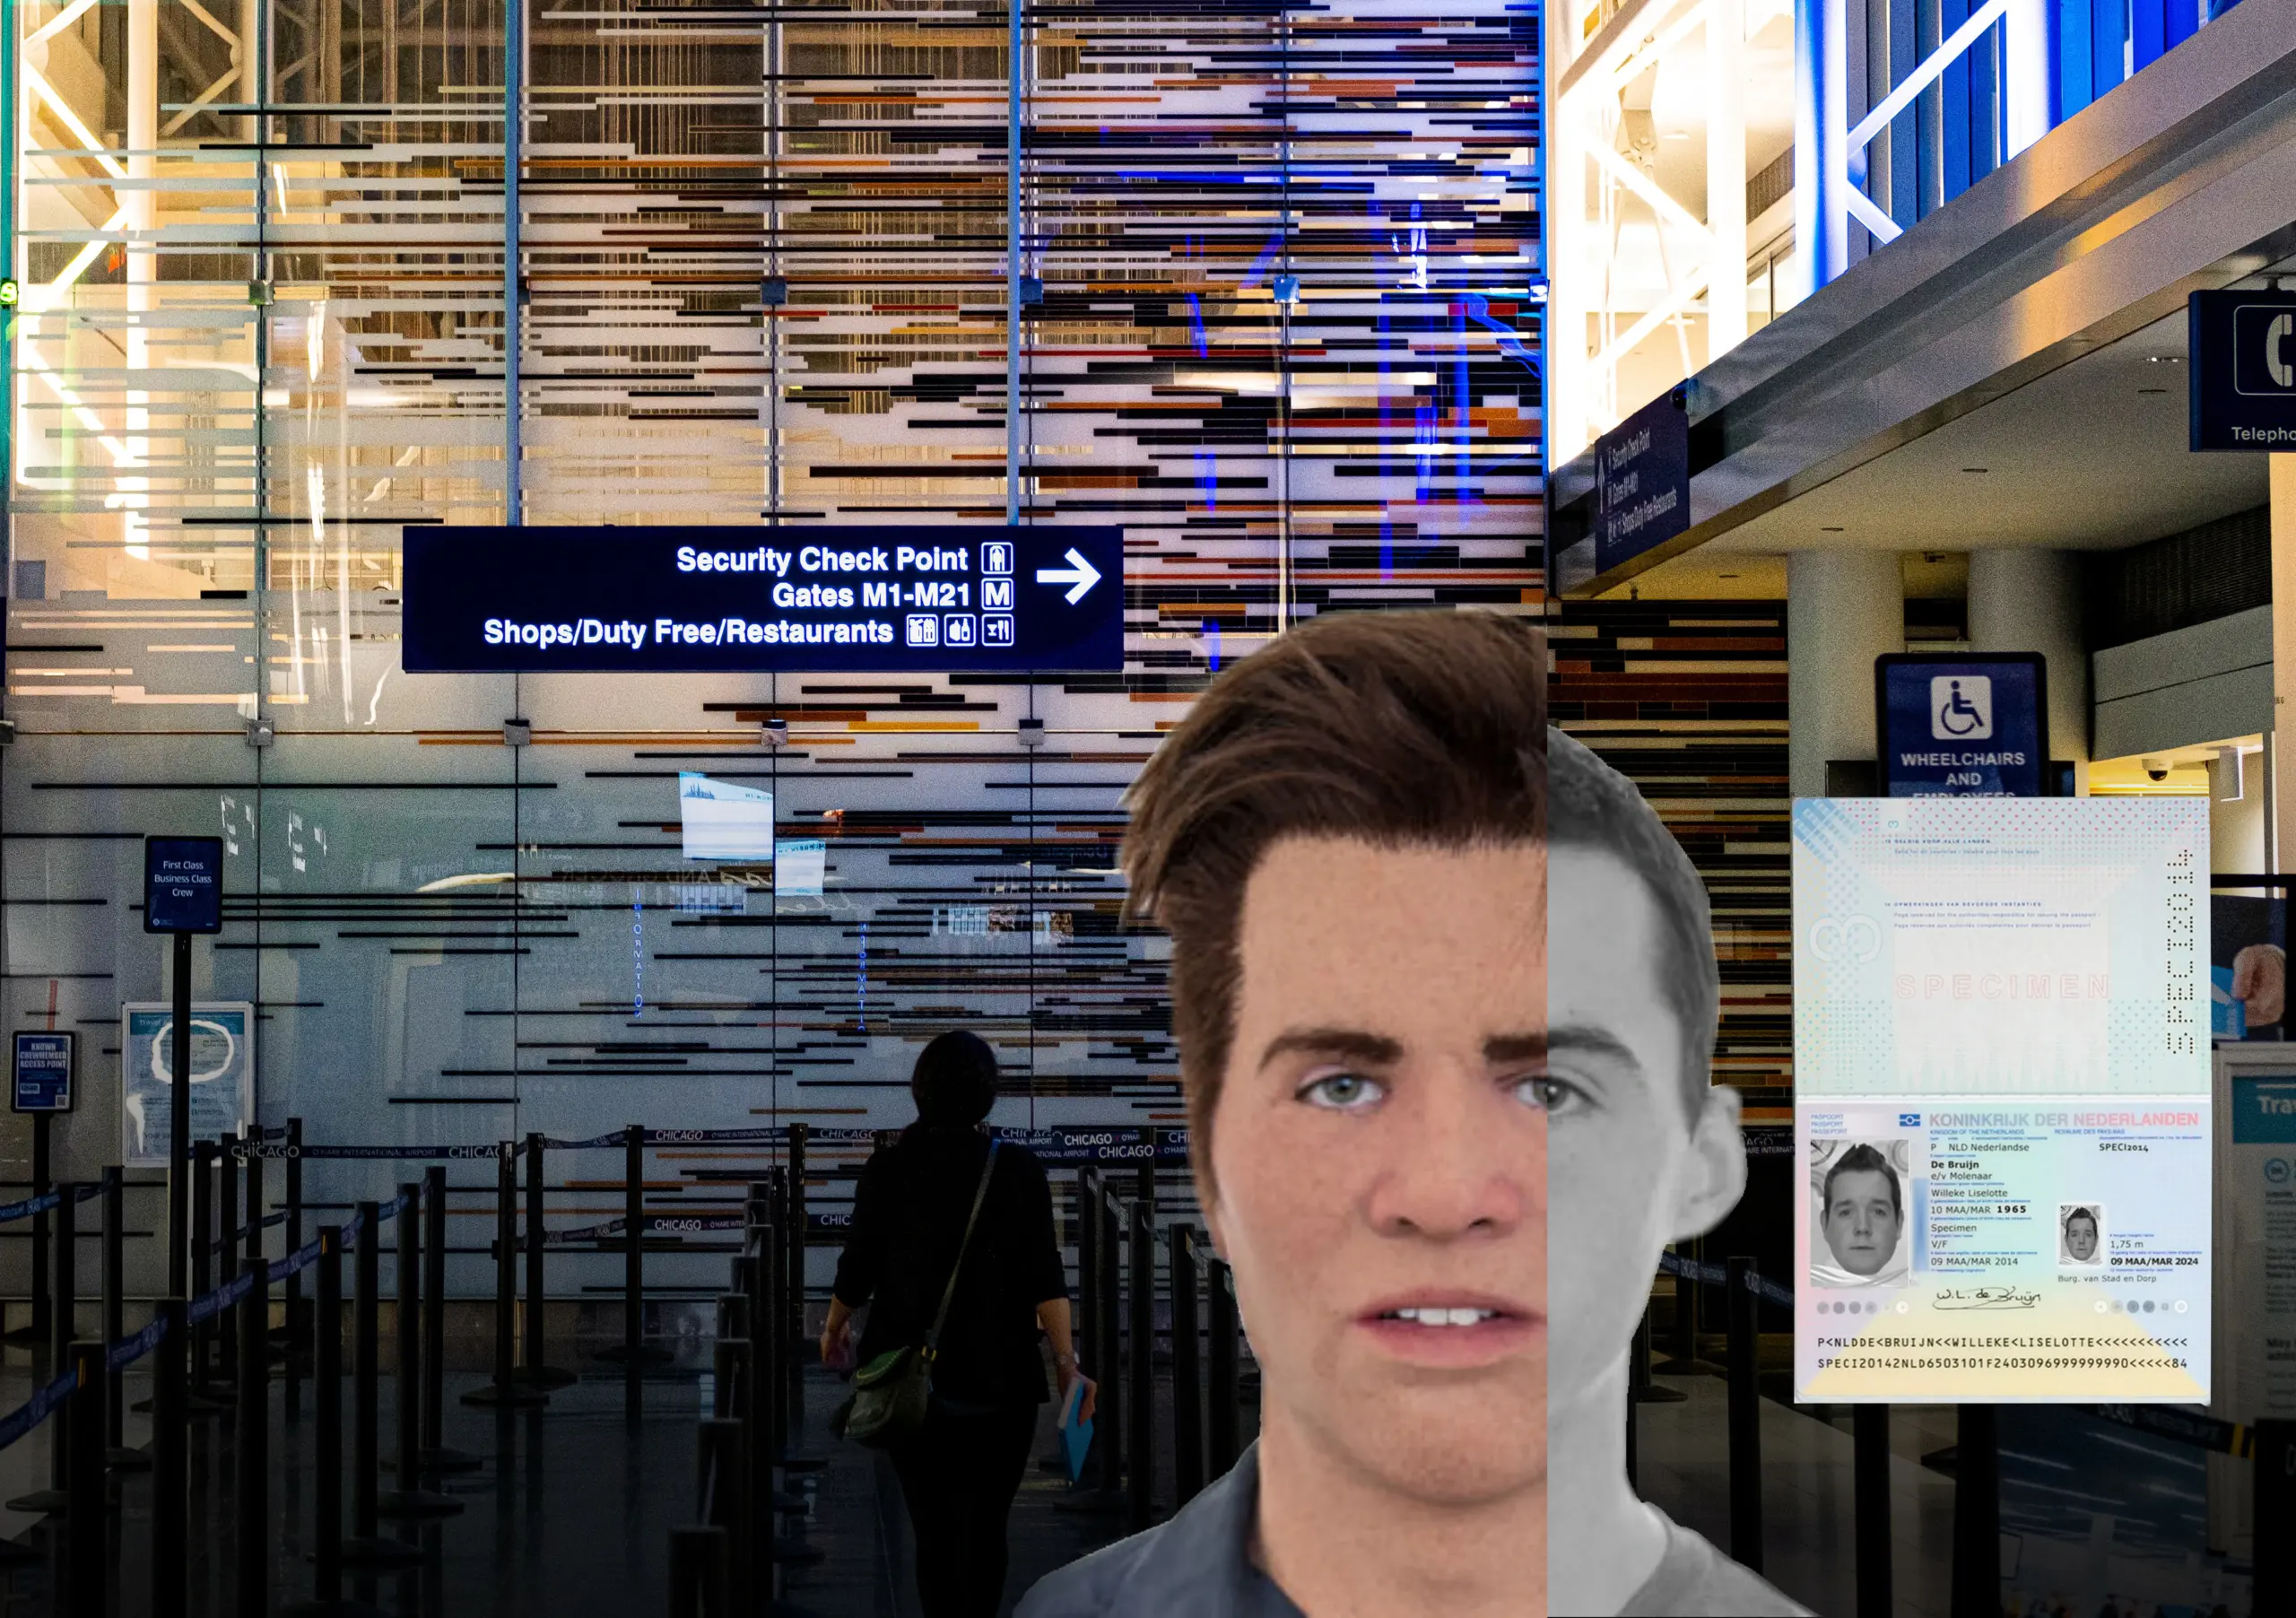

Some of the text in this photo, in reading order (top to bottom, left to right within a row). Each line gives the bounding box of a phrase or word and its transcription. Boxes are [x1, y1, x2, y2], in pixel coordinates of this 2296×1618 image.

[676, 545, 969, 577] Security Check Point
[772, 582, 854, 608] Gates
[863, 582, 970, 608] M1-M21
[484, 618, 894, 650] Shops/Duty Free/Restaurants
[1900, 752, 2026, 767] WHEELCHAIRS
[1945, 772, 1982, 786] AND
[163, 860, 204, 870] First Class
[154, 874, 213, 884] Business Class
[172, 888, 194, 897] Crew
[2167, 849, 2193, 1054] SPECI2014
[1895, 974, 2109, 998] SPECIMEN
[30, 1042, 57, 1051] KNOWN
[20, 1060, 67, 1069] ACCESS POINT
[1929, 1112, 2199, 1127] KONINKRIJK DER NEDERLANDEN
[656, 1130, 704, 1141] CHICAGO
[1065, 1134, 1113, 1145] CHICAGO
[231, 1145, 300, 1158] CHICAGO
[343, 1148, 404, 1157] INTERNATIONAL
[405, 1148, 437, 1157] AIRPORT
[1064, 1149, 1090, 1158] AIRPORT
[1098, 1144, 1154, 1159] CHICAGO
[1930, 1144, 2030, 1152] P NLD Nederlandse
[2099, 1143, 2149, 1153] SPECI2014
[1931, 1161, 1979, 1170] De Bruijn
[1931, 1172, 1993, 1181] e/v Molenaar
[1931, 1189, 2008, 1197] Willeke Liselotte
[1931, 1205, 2027, 1215] 10 MAA/MAR 1965
[655, 1218, 702, 1231] CHICAGO
[1931, 1223, 1978, 1233] Specimen
[1931, 1240, 1948, 1248] V/F
[2110, 1240, 2132, 1249] 1,75
[1931, 1257, 2019, 1266] 09 MAA/MAR 2014
[2111, 1257, 2199, 1266] 09 MAA/MAR 2024
[2057, 1275, 2081, 1283] Burg.
[2136, 1275, 2157, 1283] Dorp
[1975, 1288, 1991, 1300] de
[1817, 1338, 2188, 1347] P<NLDDE<BRUIJN<<WILLEKE<LISELOTTE<<<<<<<<<<<
